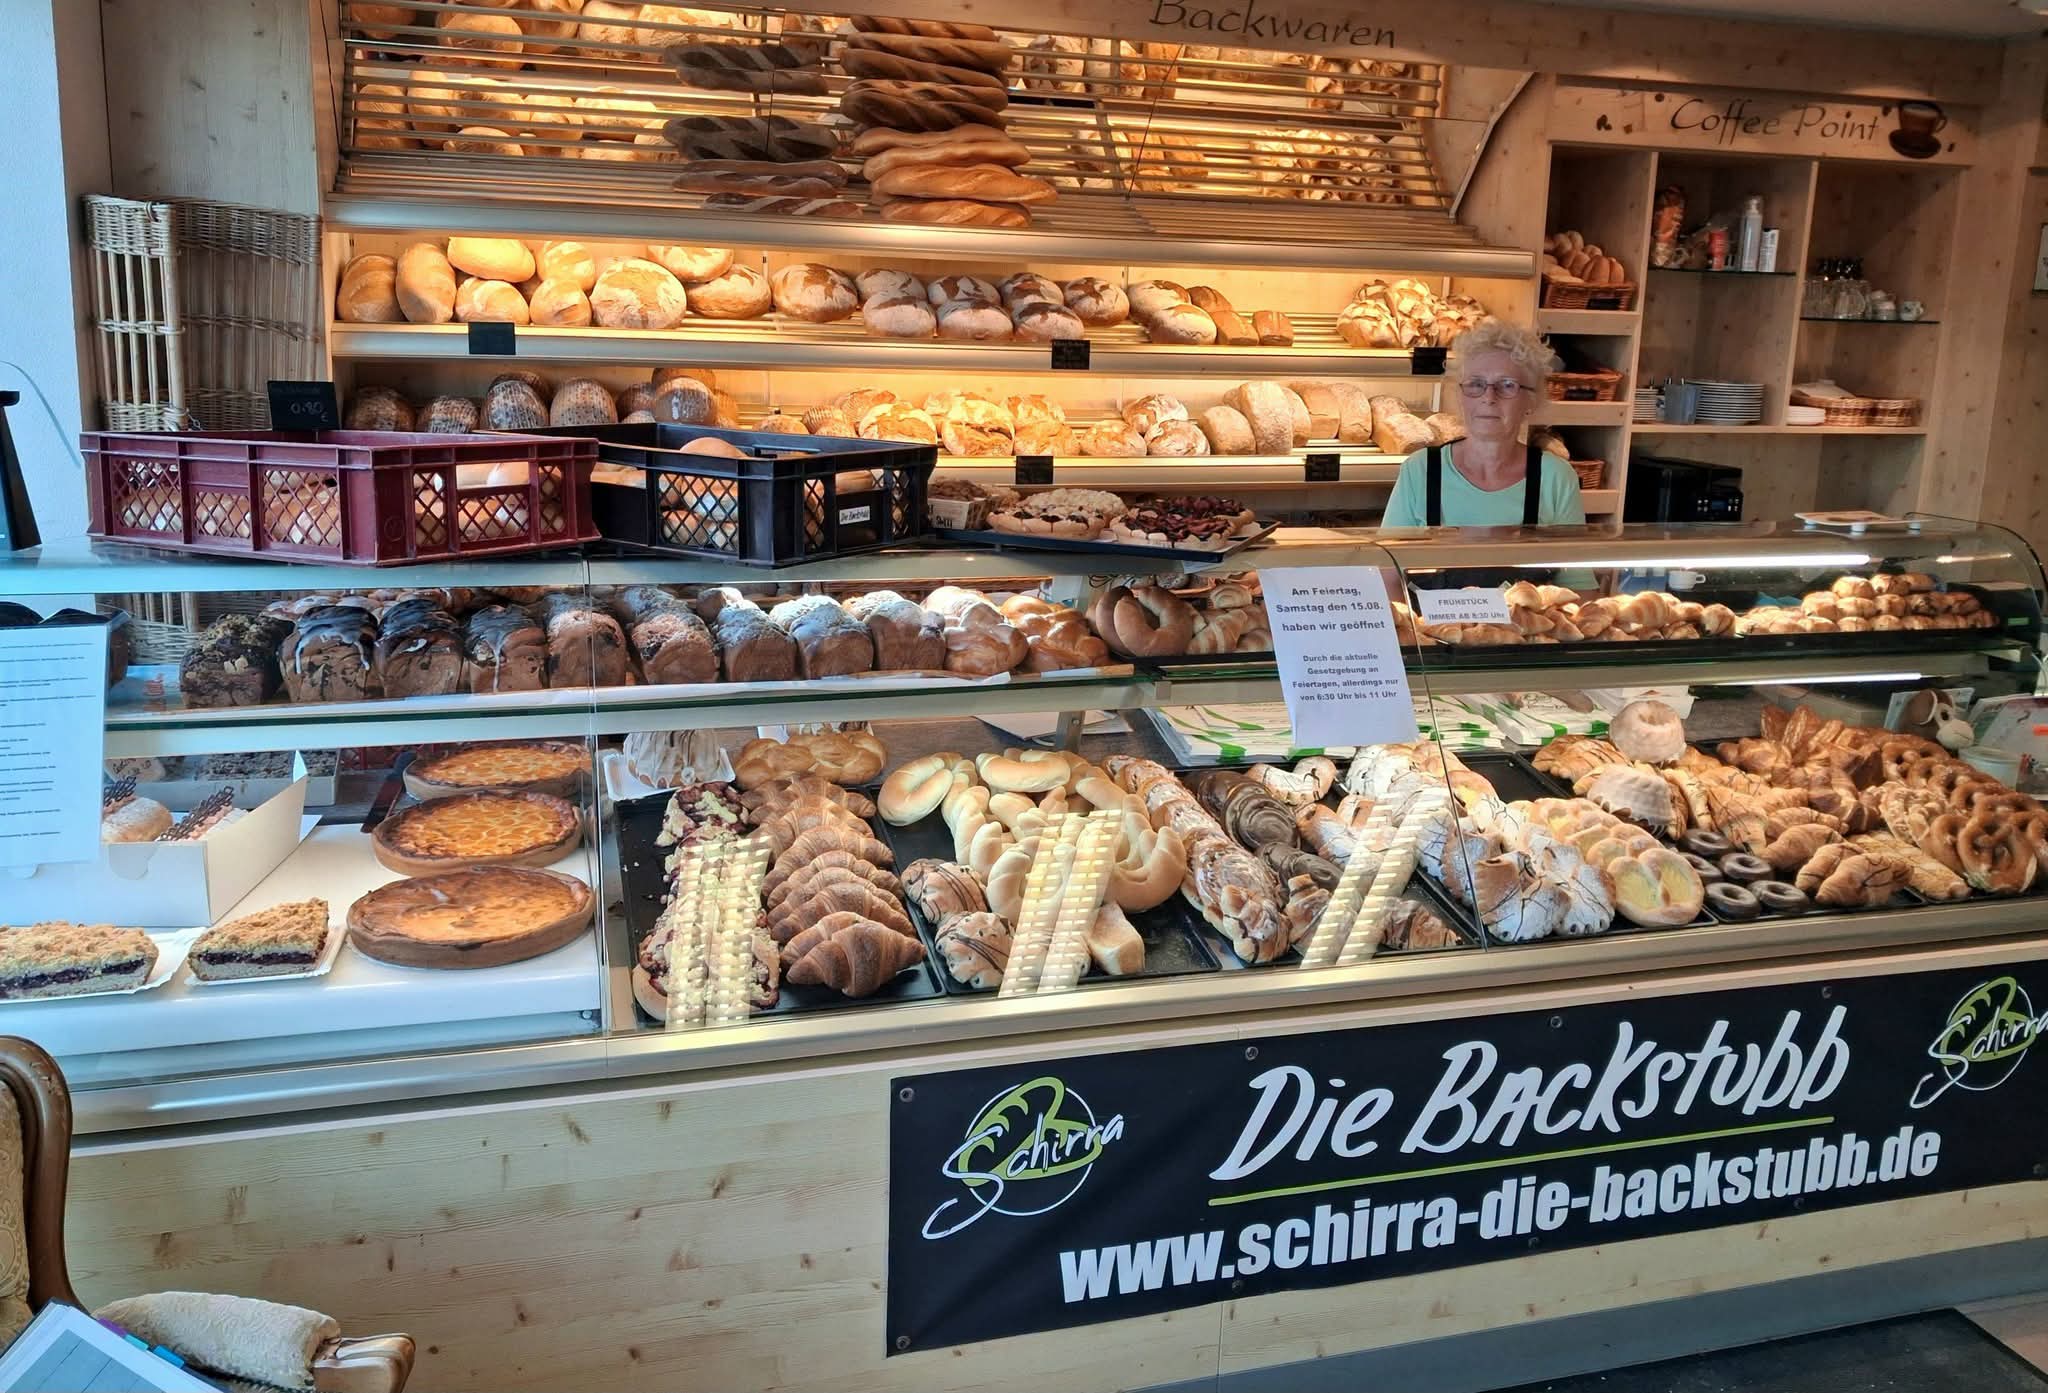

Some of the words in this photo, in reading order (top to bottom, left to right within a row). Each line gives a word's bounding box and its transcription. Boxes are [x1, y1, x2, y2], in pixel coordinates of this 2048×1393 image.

[1148, 0, 1396, 49] Backwaren
[1669, 98, 1780, 145] Coffee
[1792, 103, 1881, 141] Point
[1291, 588, 1310, 596] Am
[1312, 587, 1361, 597] Feiertag,
[1276, 604, 1325, 614] Samstag
[1328, 603, 1348, 611] den
[1351, 602, 1383, 611] 15.08.
[1428, 613, 1456, 621] IMMER
[1282, 622, 1317, 632] haben
[1319, 622, 1336, 631] wir
[1340, 620, 1385, 632] geöffnet
[1330, 654, 1343, 662] die
[1345, 653, 1378, 661] aktuelle
[1307, 666, 1367, 676] Gesetzgebung
[1292, 680, 1341, 689] Feiertagen,
[1342, 679, 1383, 688] allerdings
[1317, 693, 1335, 701] 6:30
[1354, 692, 1367, 700] bis
[1208, 1064, 1394, 1181] Die
[922, 1112, 1125, 1241] Schirra
[1059, 1126, 1941, 1304] www.schirra-die-backstubb.de
